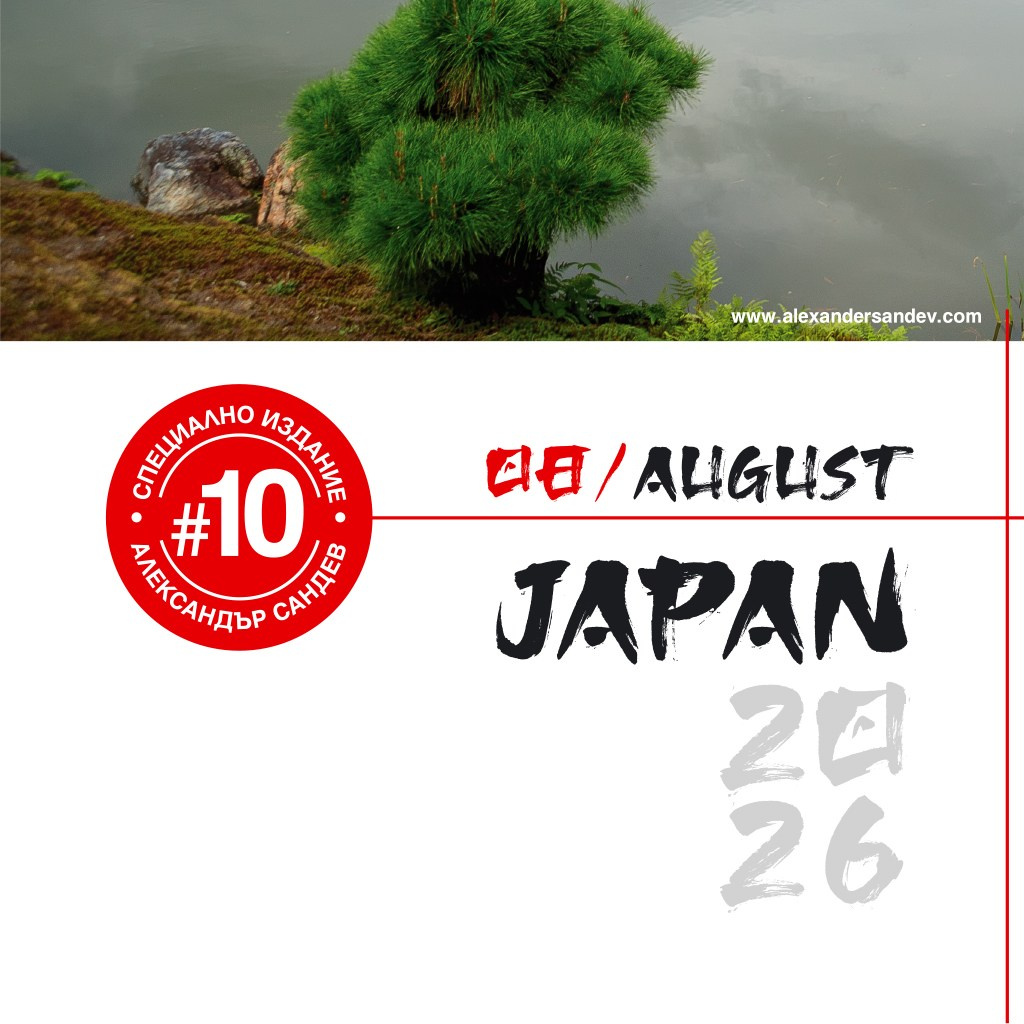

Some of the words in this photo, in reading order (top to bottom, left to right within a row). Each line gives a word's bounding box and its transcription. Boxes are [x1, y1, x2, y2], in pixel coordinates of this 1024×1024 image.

[132, 405, 255, 500] СПЕЦИАЛНО
[261, 409, 347, 504] ИЗДАНИЕ
[171, 468, 305, 558] #10
[130, 543, 267, 633] АЛЕКСАНДЪР
[272, 542, 347, 621] САНДЕВ
[496, 547, 908, 665] JAPAN
[720, 682, 906, 791] 20
[720, 795, 904, 913] 26
